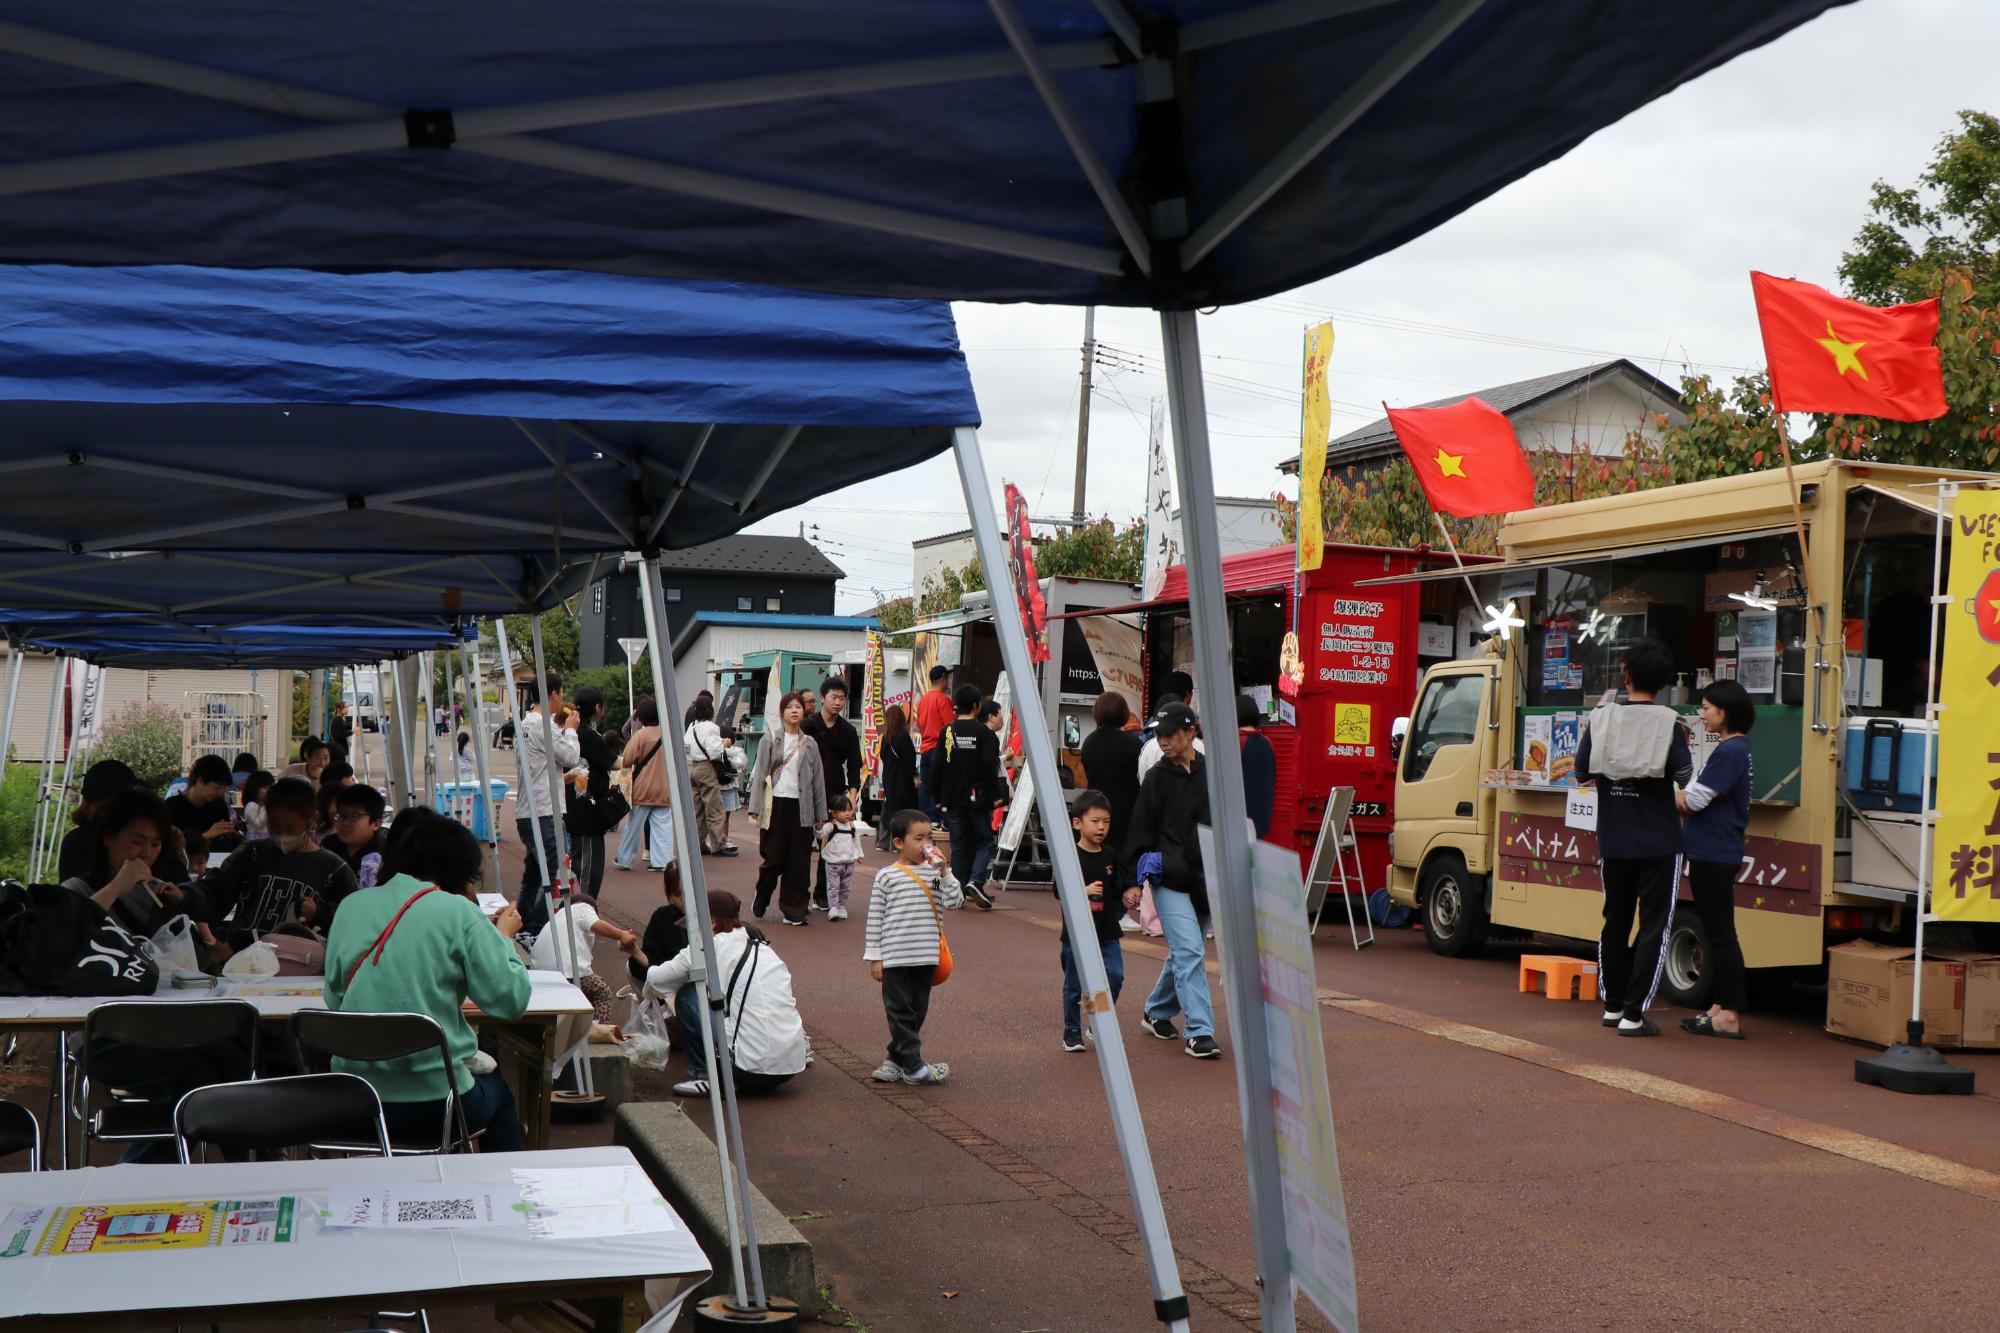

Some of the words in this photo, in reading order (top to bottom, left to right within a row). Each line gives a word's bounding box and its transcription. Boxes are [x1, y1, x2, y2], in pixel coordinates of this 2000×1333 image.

[1959, 513, 2000, 538] VIE
[1334, 599, 1384, 617] 爆弾餃子
[1321, 623, 1374, 639] 無人販売所
[1352, 655, 1390, 669] 1-2-13
[1320, 668, 1388, 685] 24時間営業中
[872, 679, 885, 726] POTATO
[1569, 802, 1594, 817] 注文口
[1515, 826, 1580, 859] ベトナム
